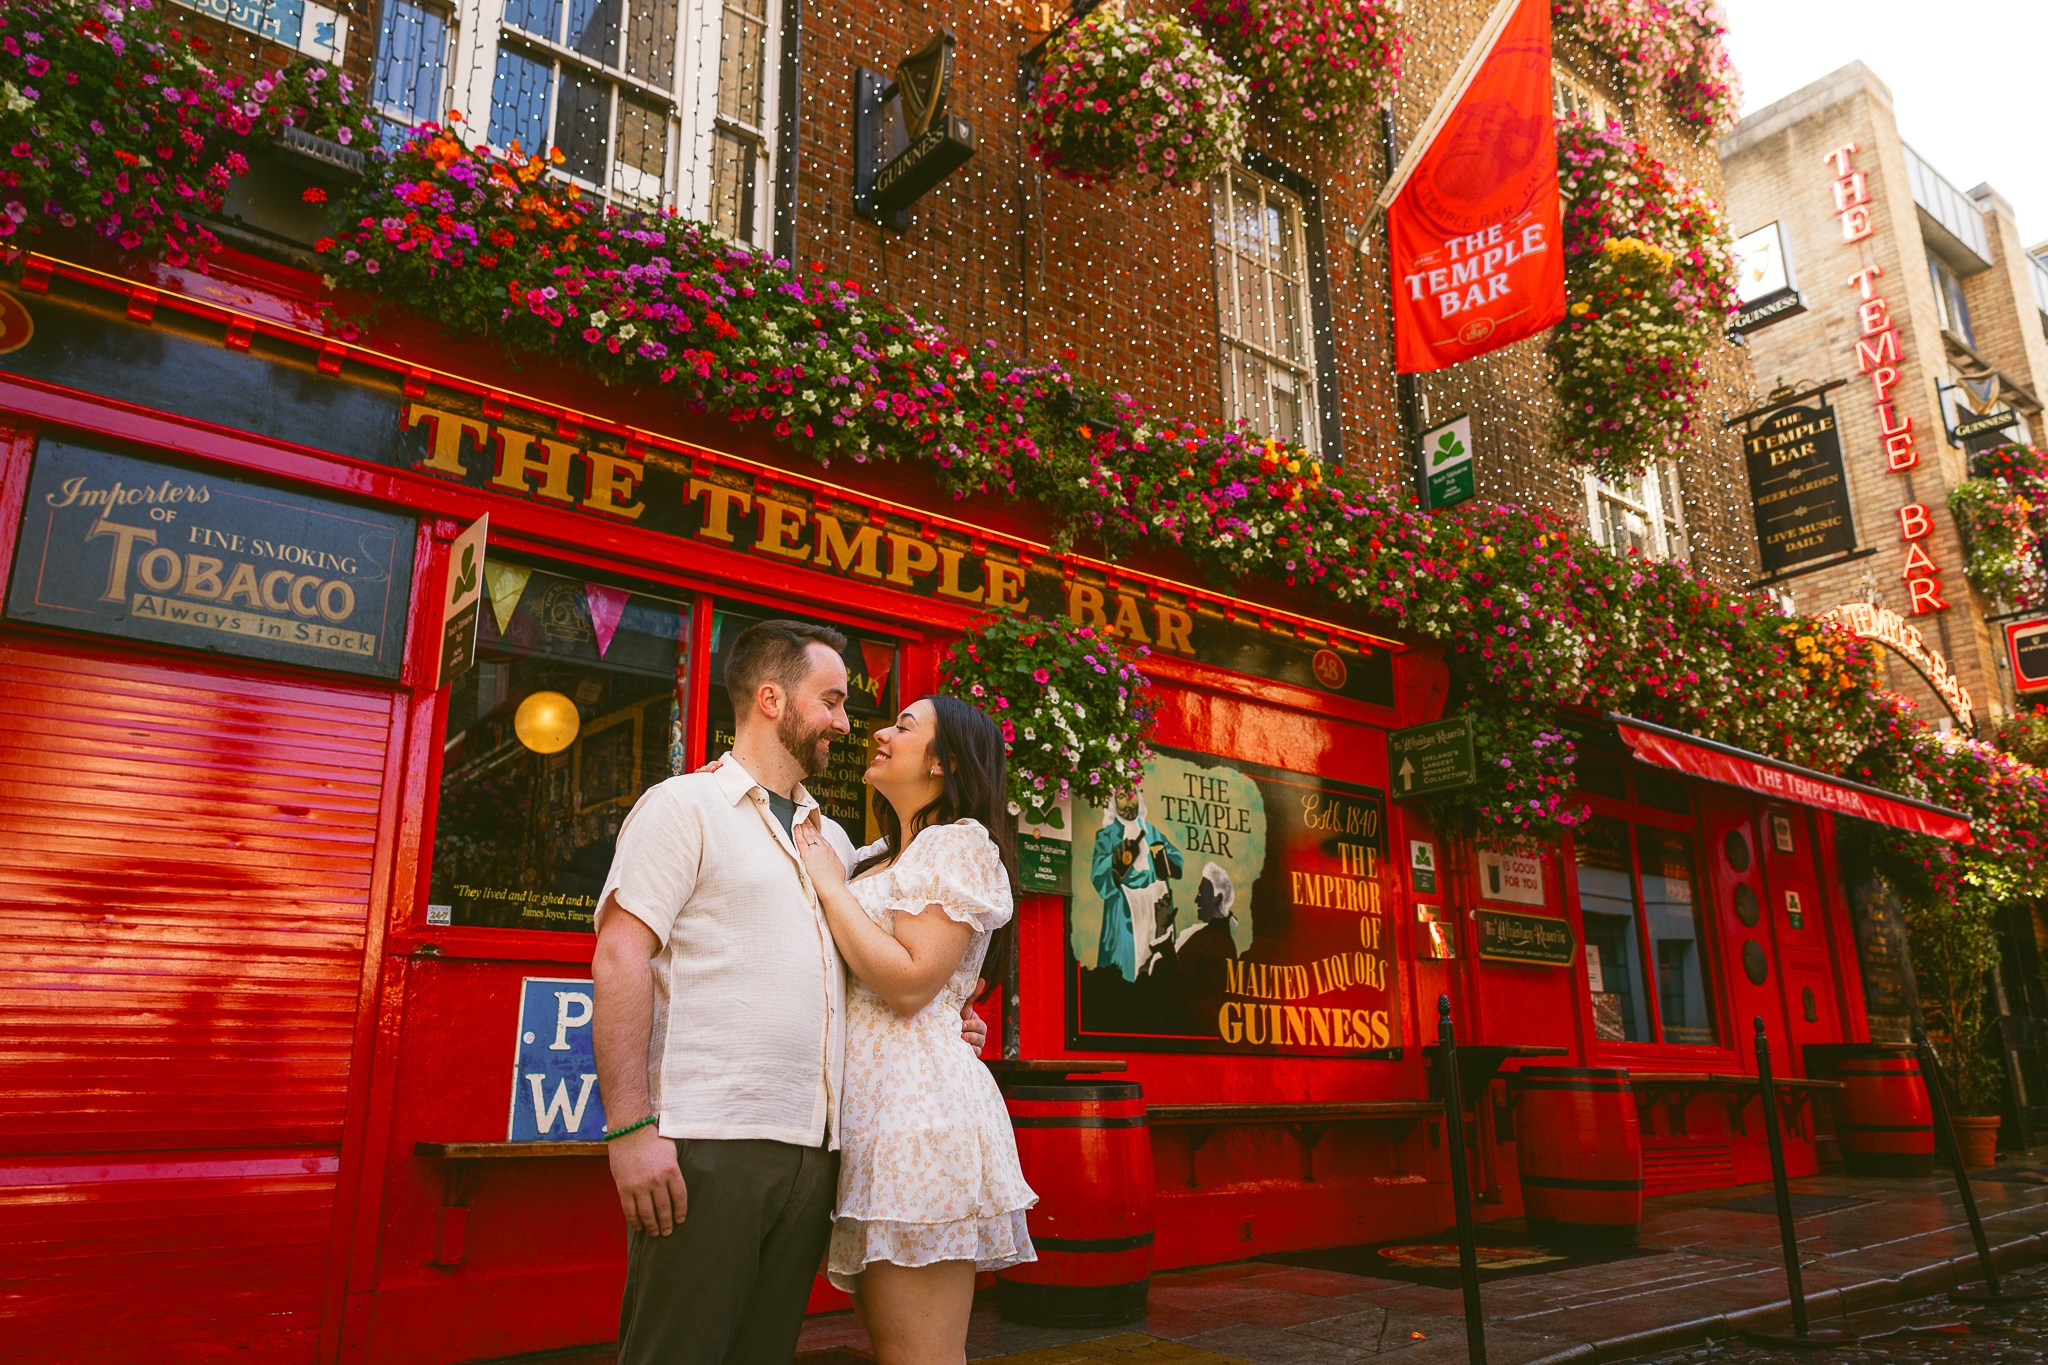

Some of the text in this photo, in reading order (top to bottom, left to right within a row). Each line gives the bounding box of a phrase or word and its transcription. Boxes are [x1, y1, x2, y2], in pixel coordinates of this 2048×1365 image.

[877, 125, 945, 192] GUINNESS
[1444, 223, 1504, 260] THE
[1404, 223, 1547, 302] TEMPLE
[1438, 272, 1510, 319] BAR
[1735, 294, 1797, 327] GUINNESS
[1823, 142, 1951, 616] THE TEMPLE BAR
[1747, 416, 1834, 454] TEMPLE
[1772, 412, 1803, 429] THE
[1955, 413, 2012, 436] GUINNESS
[1769, 441, 1817, 467] BAR
[46, 476, 210, 519] Importers
[1758, 473, 1839, 506] BEER GARDEN
[150, 507, 178, 524] OF
[409, 403, 1196, 655] THE TEMPLE BAR
[1766, 515, 1842, 545] LIVE MUSIC
[189, 525, 358, 575] FINE SMOKING
[1785, 533, 1826, 553] DAILY
[85, 520, 357, 624] TOBACCO
[135, 595, 371, 654] Always in Stock
[1318, 656, 1338, 680] 48
[1927, 650, 1973, 728] BAR
[1183, 772, 1230, 804] THE
[1753, 764, 1863, 811] THE TEMPLE BAR
[832, 804, 860, 819] Rolls
[1161, 795, 1252, 834] TEMPLE
[1346, 806, 1377, 838] 1840
[1024, 841, 1040, 852] Teach
[1040, 854, 1051, 863] Pub
[1186, 825, 1233, 859] BAR
[1337, 842, 1378, 879] THE
[1503, 860, 1537, 875] IS GOOD
[483, 887, 507, 900] lived
[508, 890, 527, 901] and
[528, 890, 566, 906] laghed
[566, 894, 584, 906] and
[1290, 871, 1382, 915] EMPEROR
[1504, 875, 1538, 890] FOR YOU
[522, 906, 544, 918] James
[545, 908, 567, 921] Joyce,
[1360, 916, 1382, 950] OF
[1225, 951, 1388, 1000] MALTED LIQUORS
[1218, 1001, 1391, 1049] GUINNESS
